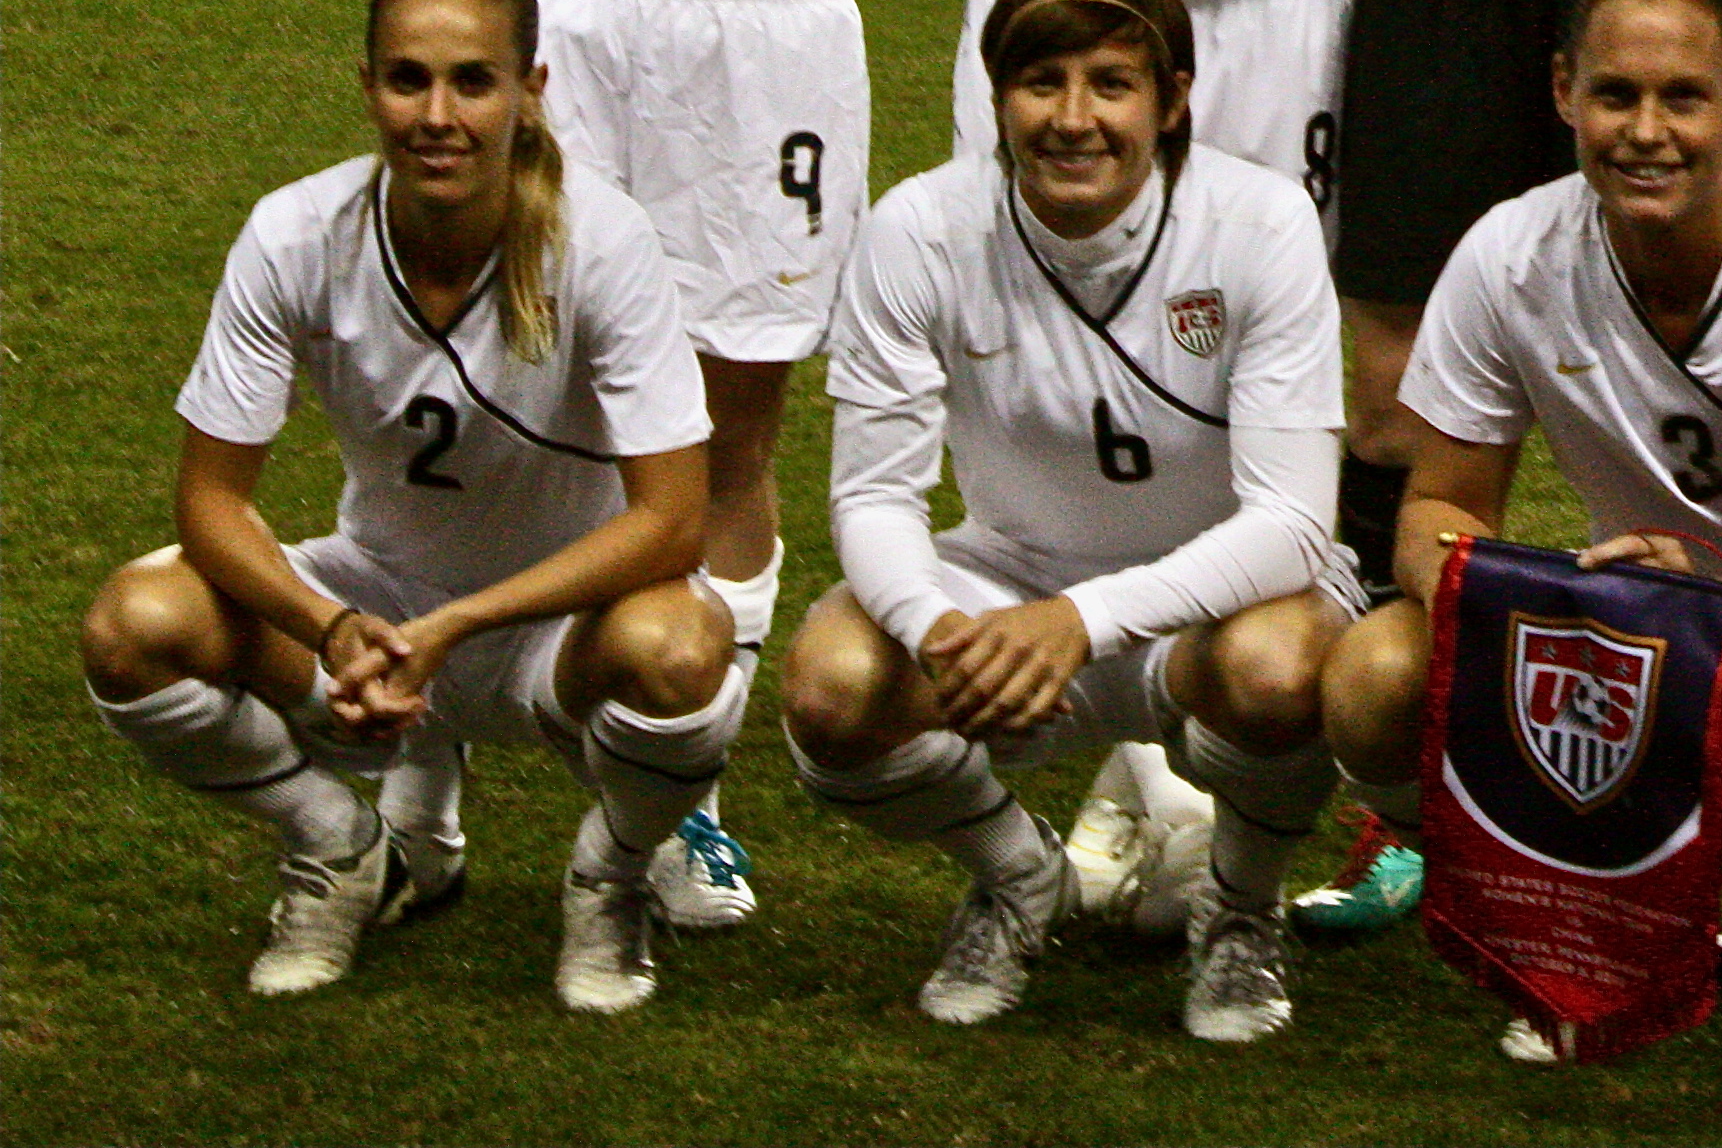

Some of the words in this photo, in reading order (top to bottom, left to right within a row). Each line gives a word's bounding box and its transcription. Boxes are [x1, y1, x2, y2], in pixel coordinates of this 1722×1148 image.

[779, 131, 824, 235] 9
[1305, 111, 1335, 212] 8
[405, 395, 462, 492] 2
[1092, 397, 1151, 483] 6
